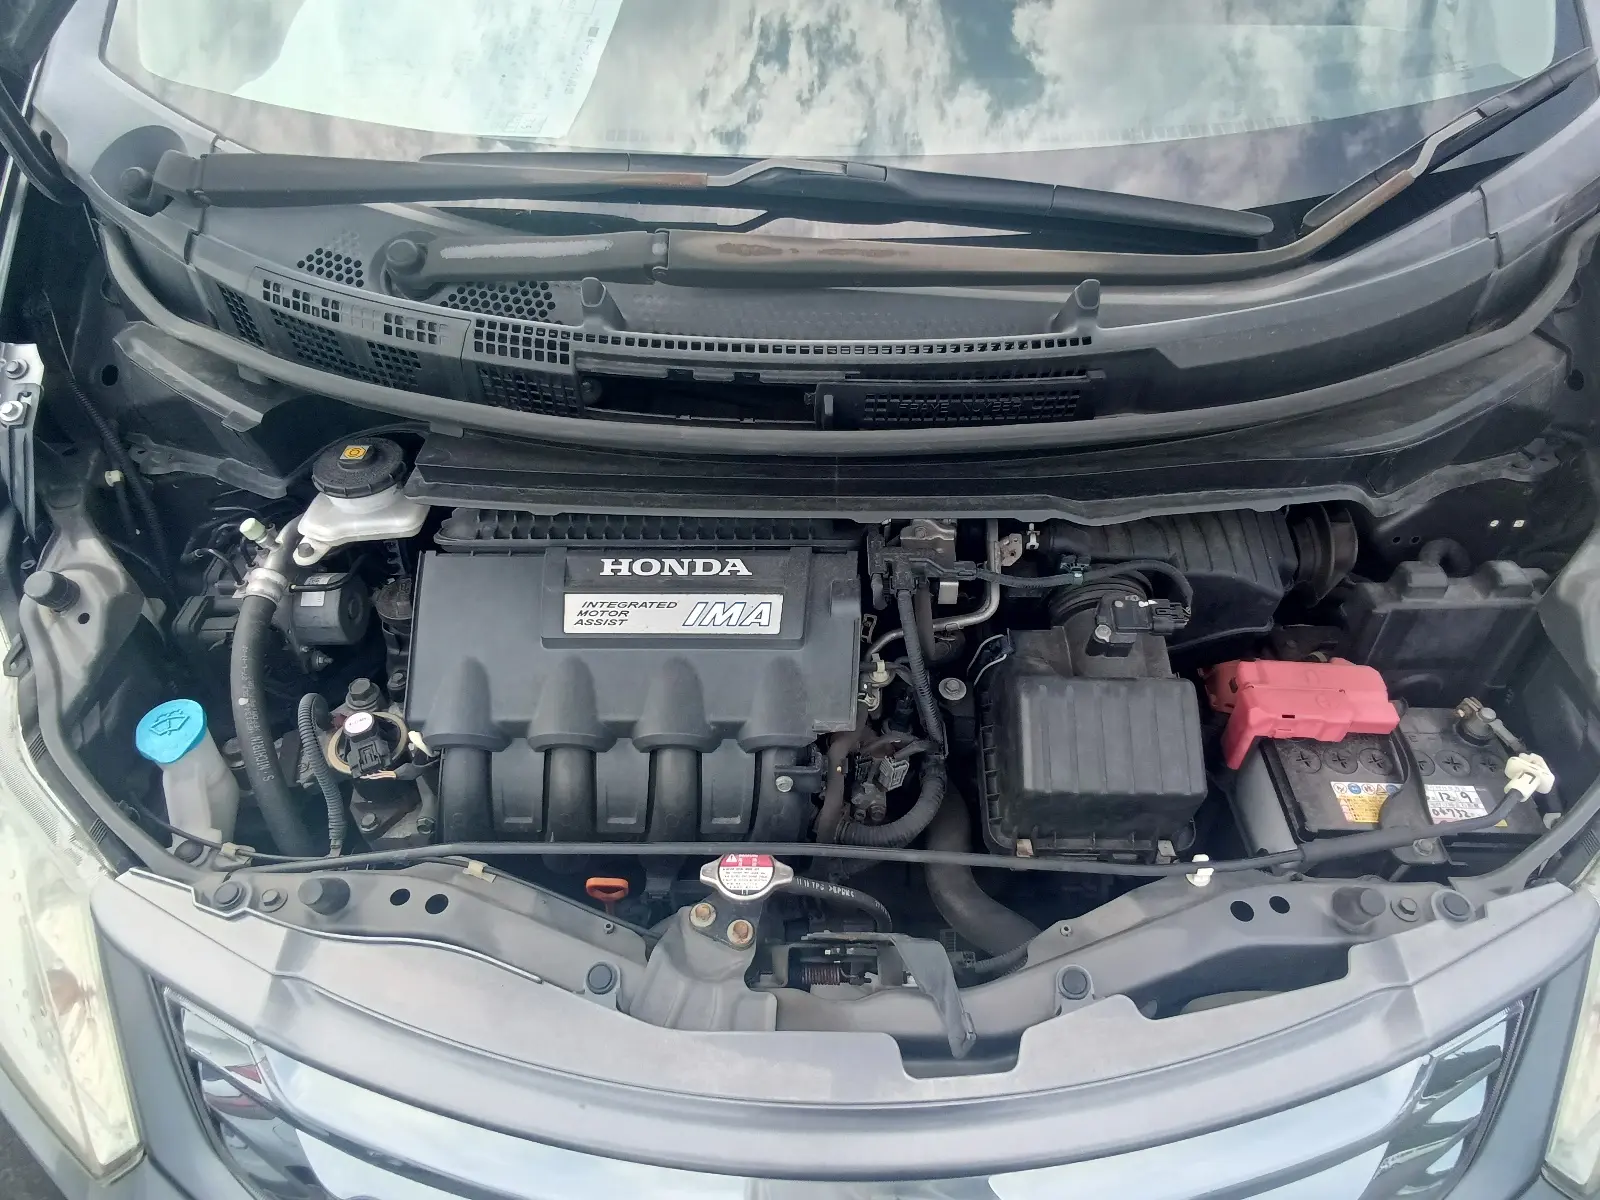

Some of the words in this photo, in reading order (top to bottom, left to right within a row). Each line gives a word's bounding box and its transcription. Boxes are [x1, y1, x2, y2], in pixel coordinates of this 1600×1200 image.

[600, 558, 752, 576] HONDA
[582, 601, 678, 609] INTEGRATED
[577, 610, 630, 618] MOTOR
[682, 602, 772, 627] IMA
